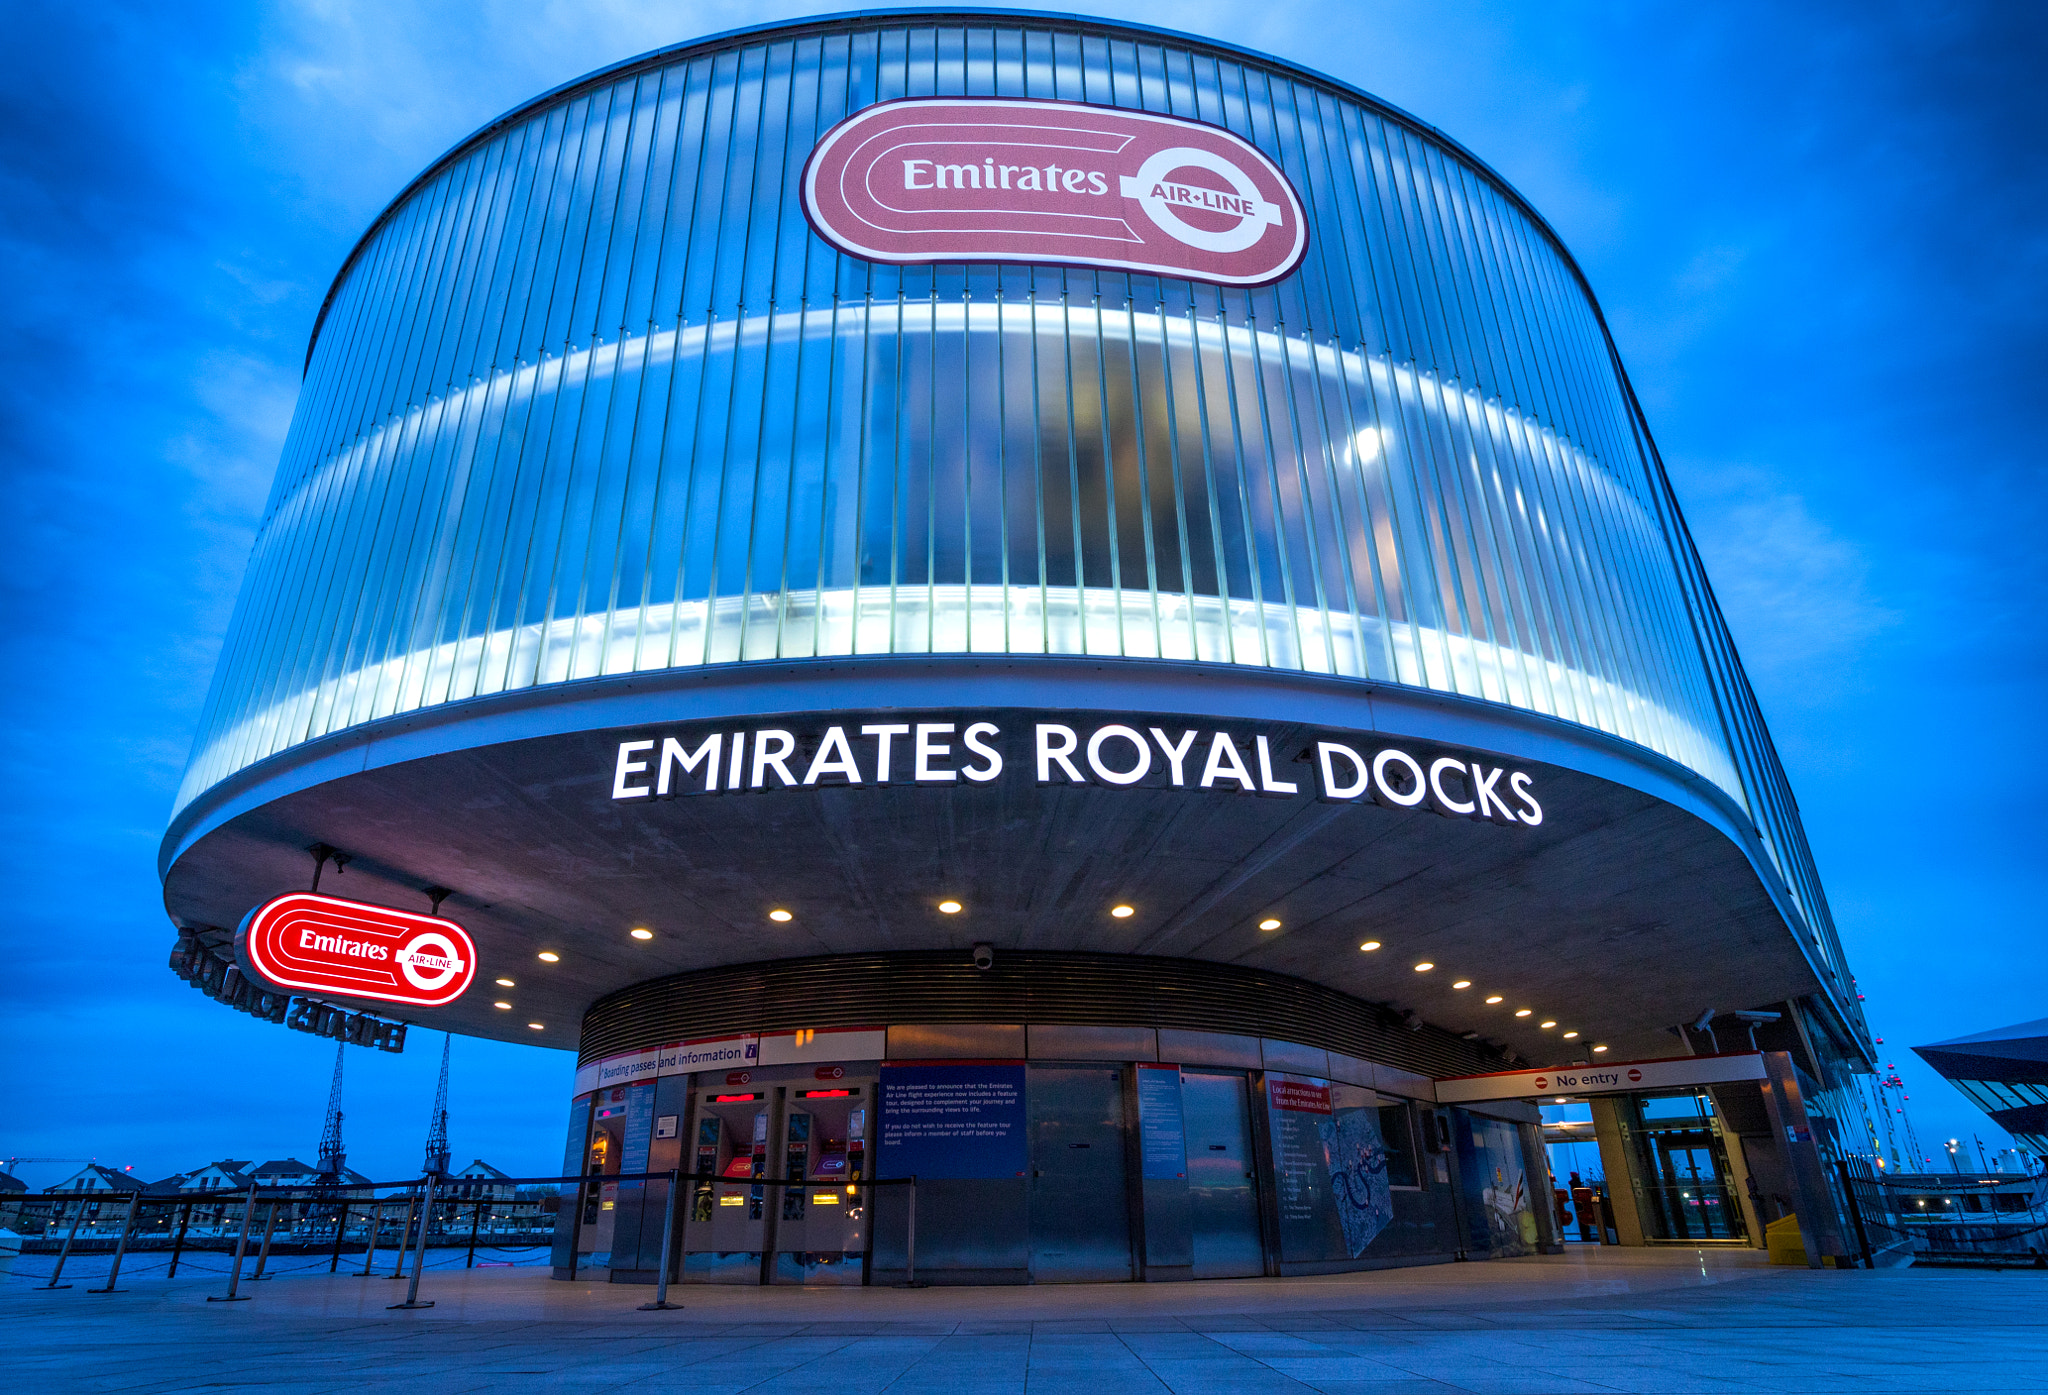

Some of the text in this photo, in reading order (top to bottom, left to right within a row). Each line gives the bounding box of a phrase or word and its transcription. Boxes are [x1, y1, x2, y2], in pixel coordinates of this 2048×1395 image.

[902, 157, 1109, 196] Emirates
[611, 722, 1544, 826] EMIRATES ROYAL DOCKS
[299, 929, 388, 961] Emirates
[604, 1048, 741, 1079] Boarding passes and information
[1556, 1074, 1618, 1086] No entry
